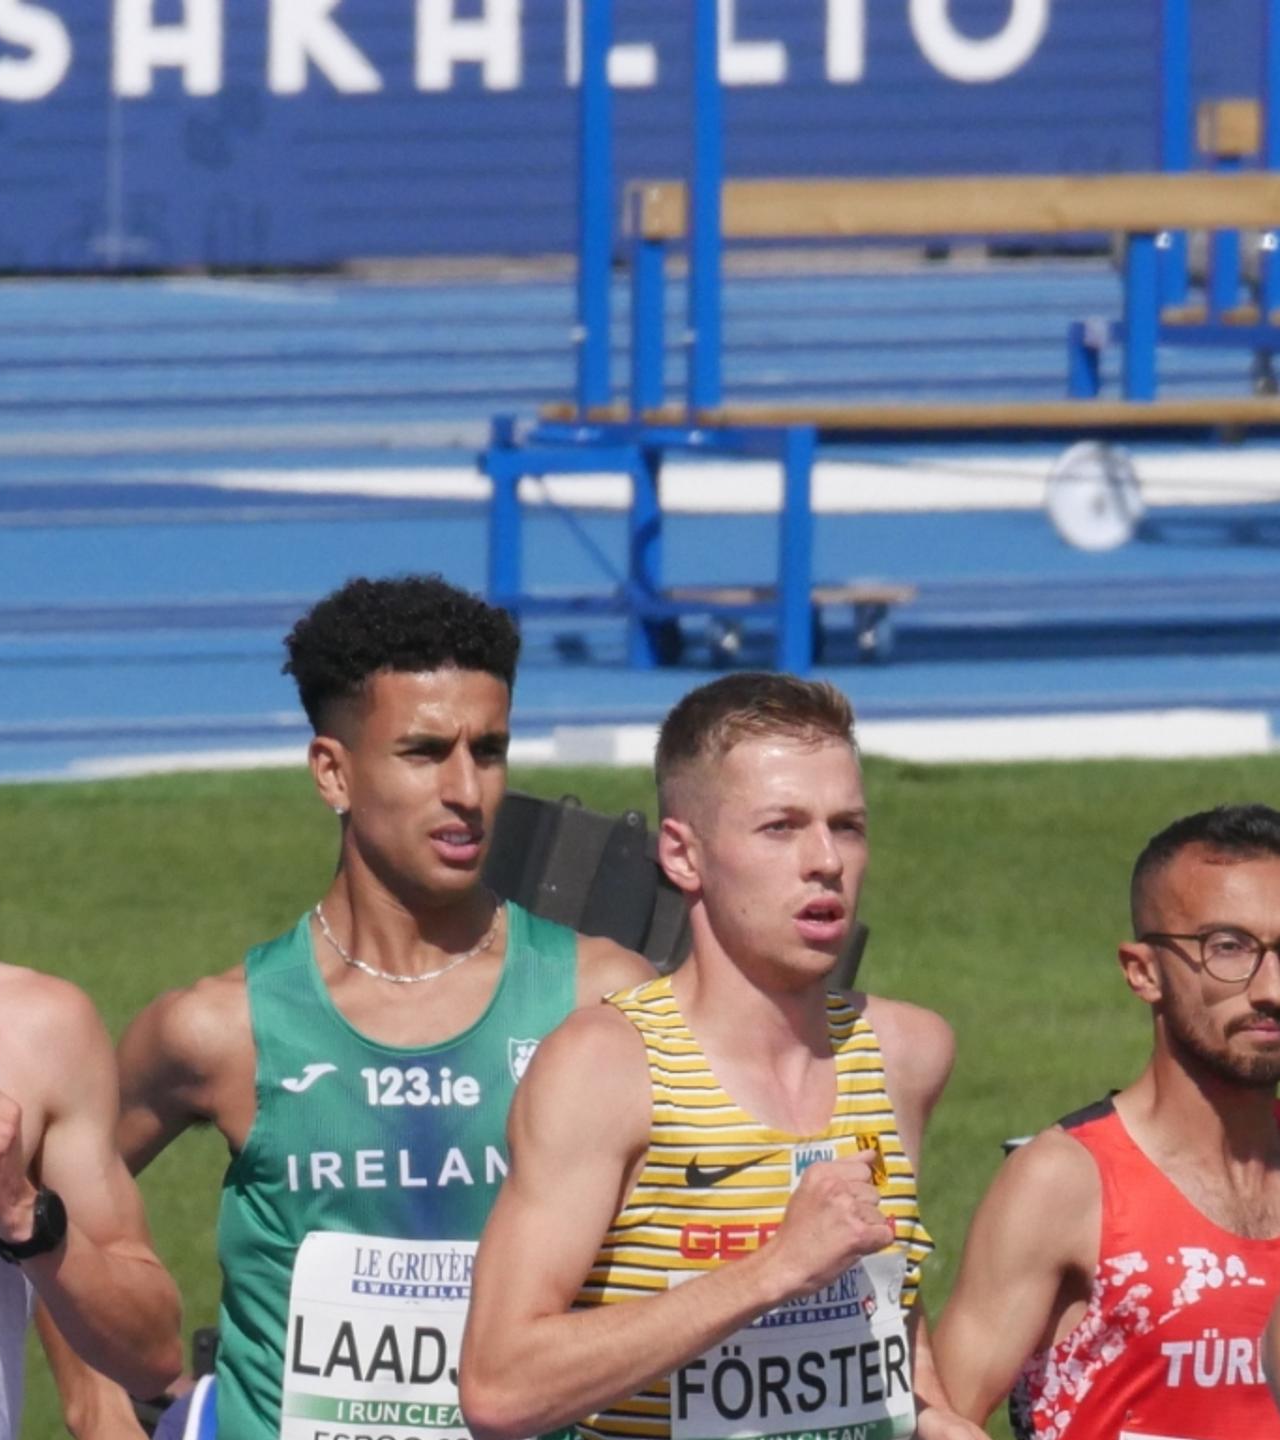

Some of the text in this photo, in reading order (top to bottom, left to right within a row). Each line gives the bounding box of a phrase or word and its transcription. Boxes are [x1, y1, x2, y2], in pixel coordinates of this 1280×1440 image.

[361, 1067, 481, 1106] 123.ie
[354, 1247, 382, 1278] LE
[677, 1335, 910, 1420] FÖRSTER
[1161, 1328, 1266, 1388] TÜR
[349, 1401, 400, 1421] RUN
